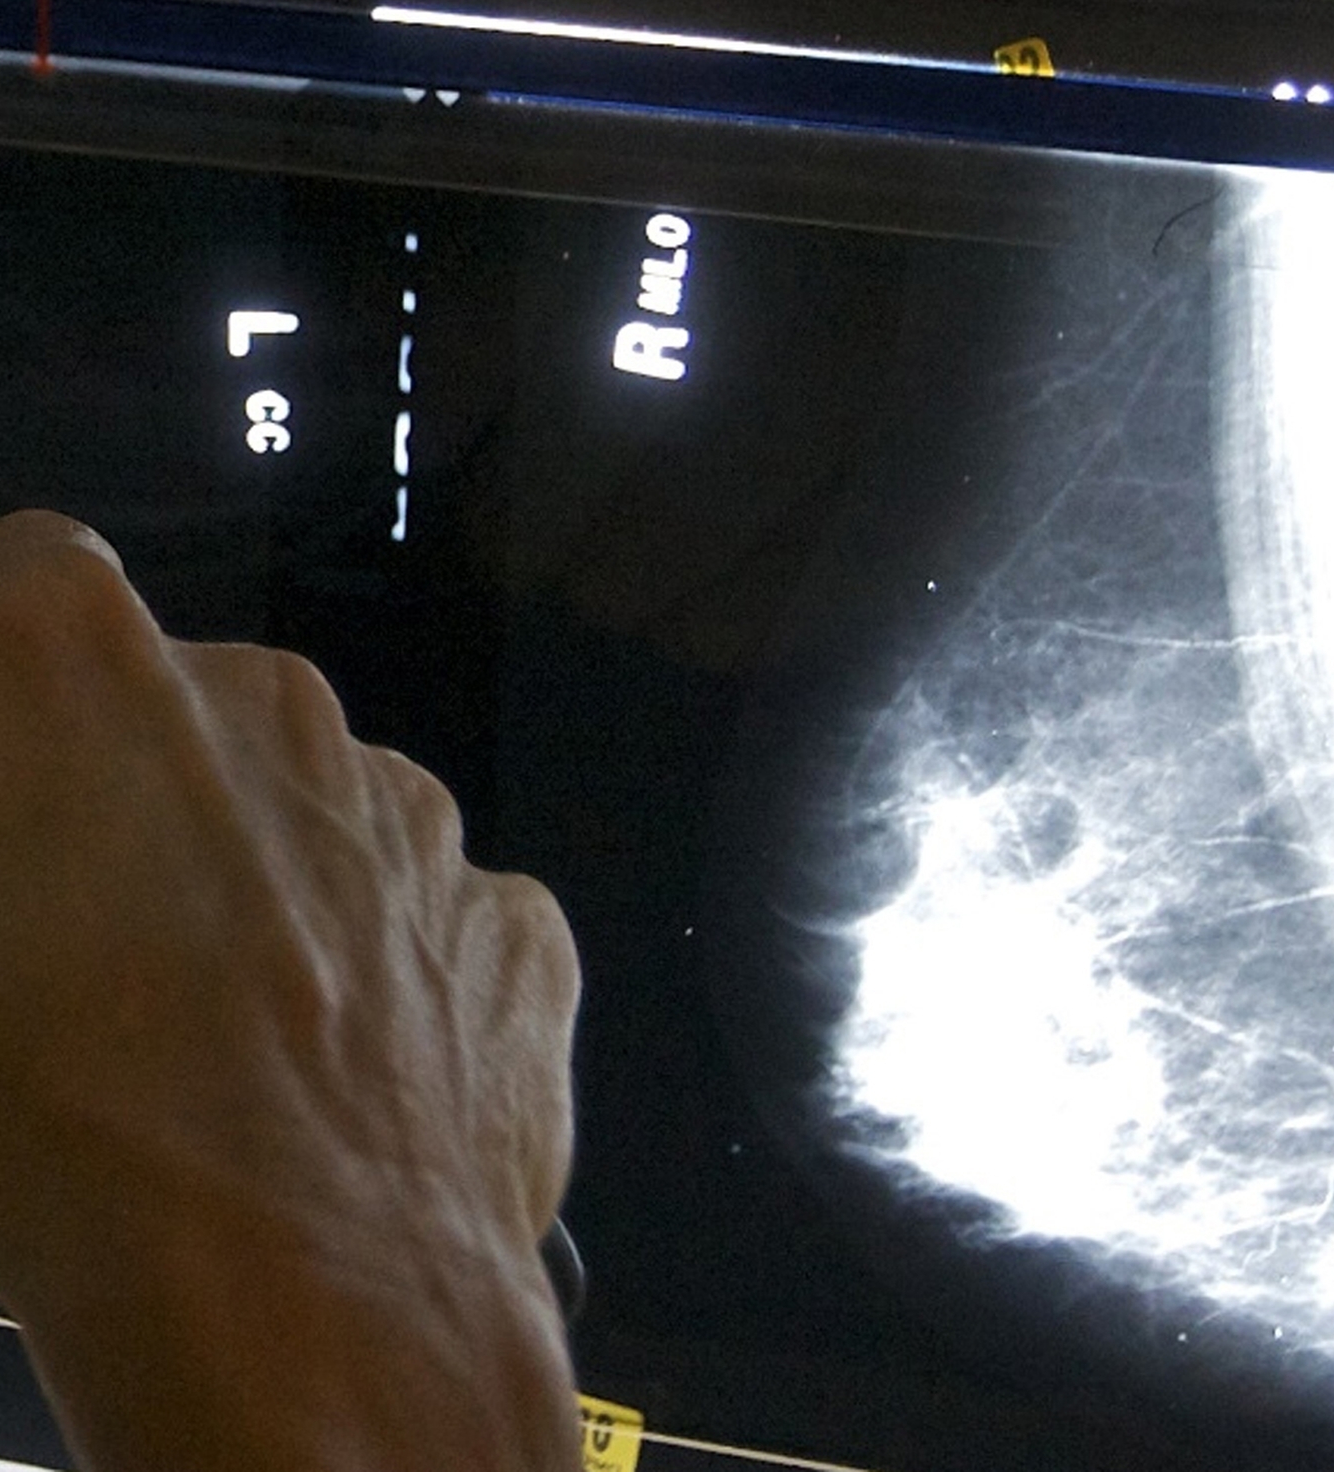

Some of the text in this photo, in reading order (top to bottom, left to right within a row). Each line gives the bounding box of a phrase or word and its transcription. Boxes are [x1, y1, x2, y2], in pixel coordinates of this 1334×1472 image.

[613, 212, 692, 381] R MLO
[228, 310, 300, 455] L CC
